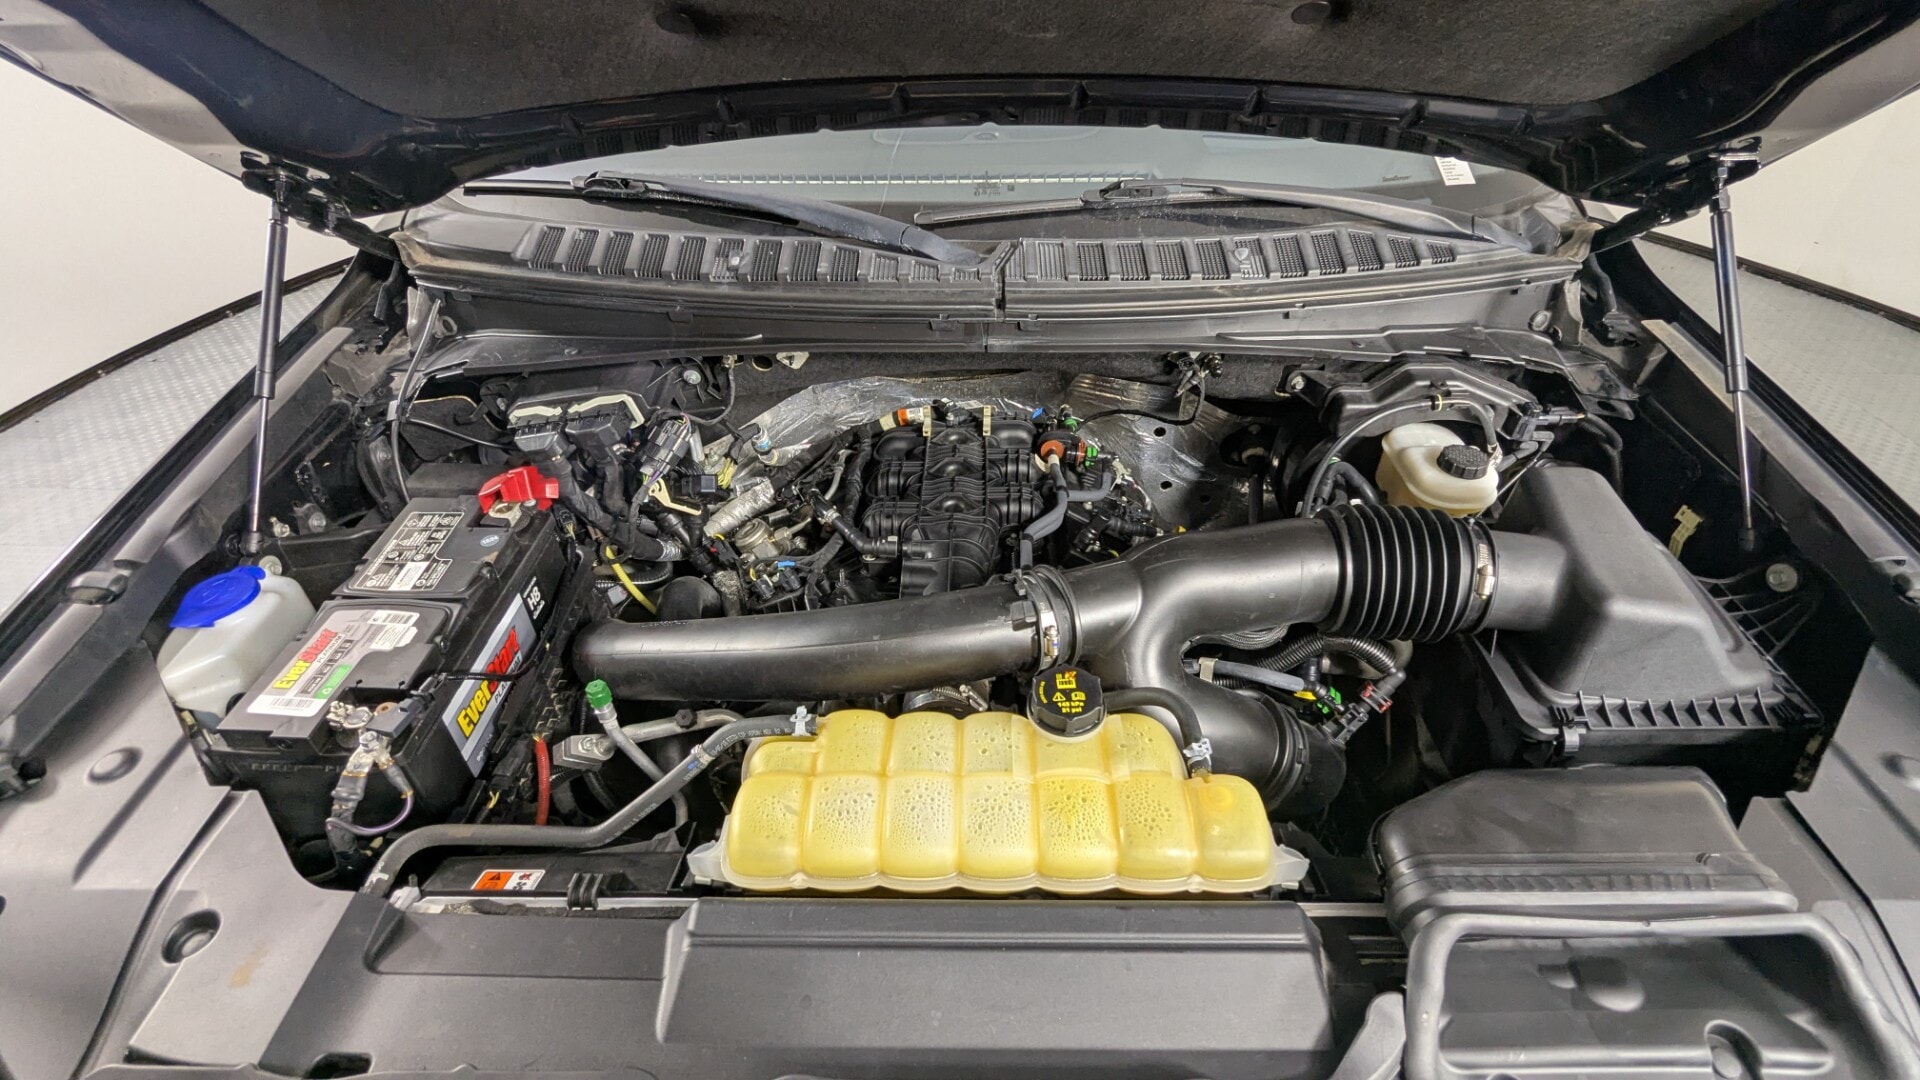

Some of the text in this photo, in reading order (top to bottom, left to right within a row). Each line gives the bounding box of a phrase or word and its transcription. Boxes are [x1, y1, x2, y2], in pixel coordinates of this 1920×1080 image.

[527, 585, 541, 611] H8
[272, 628, 338, 689] EverStart
[317, 634, 343, 664] PLATINUM
[456, 626, 520, 739] EverStart
